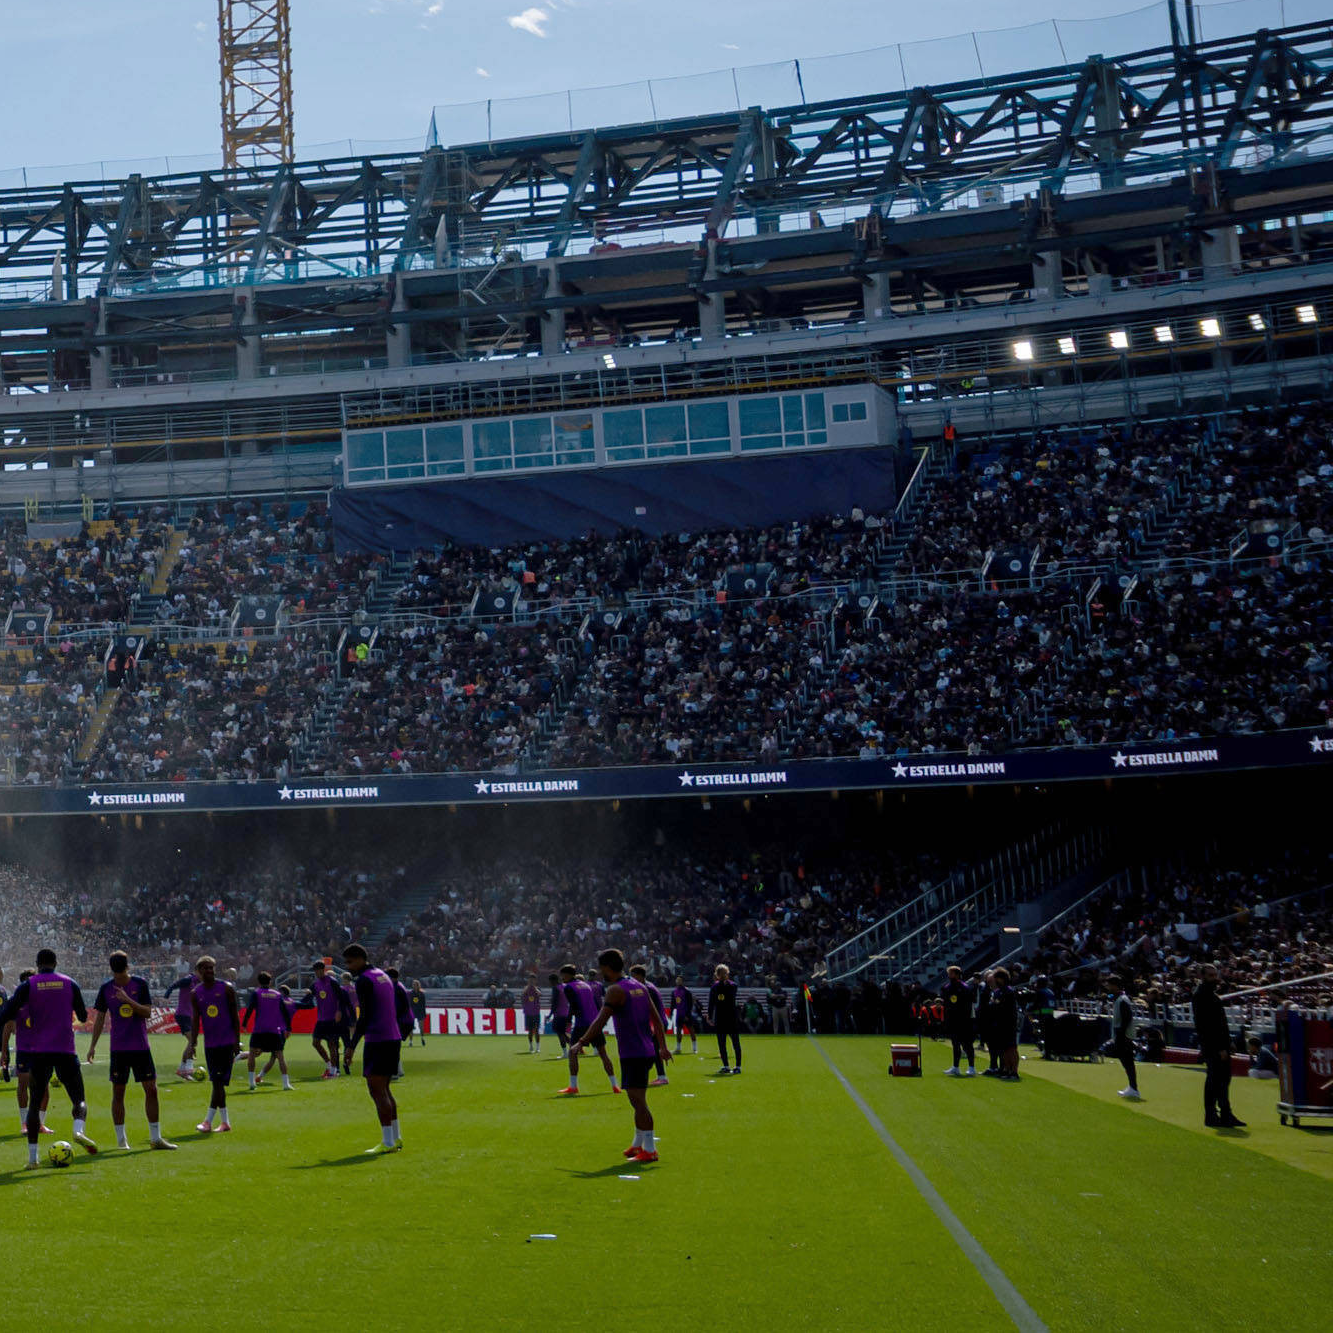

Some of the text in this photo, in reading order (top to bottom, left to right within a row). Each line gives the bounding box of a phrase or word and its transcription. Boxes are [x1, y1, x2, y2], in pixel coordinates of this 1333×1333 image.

[1129, 749, 1218, 766] ESTRELLA DAMM
[909, 762, 1005, 777] ESTRELLA DAMM
[696, 772, 787, 786] ESTRELLA DAMM
[294, 787, 378, 799] ESTRELLA DAMM
[491, 780, 578, 793] ESTRELLA DAMM
[103, 793, 185, 804] ESTRELLA DAMM
